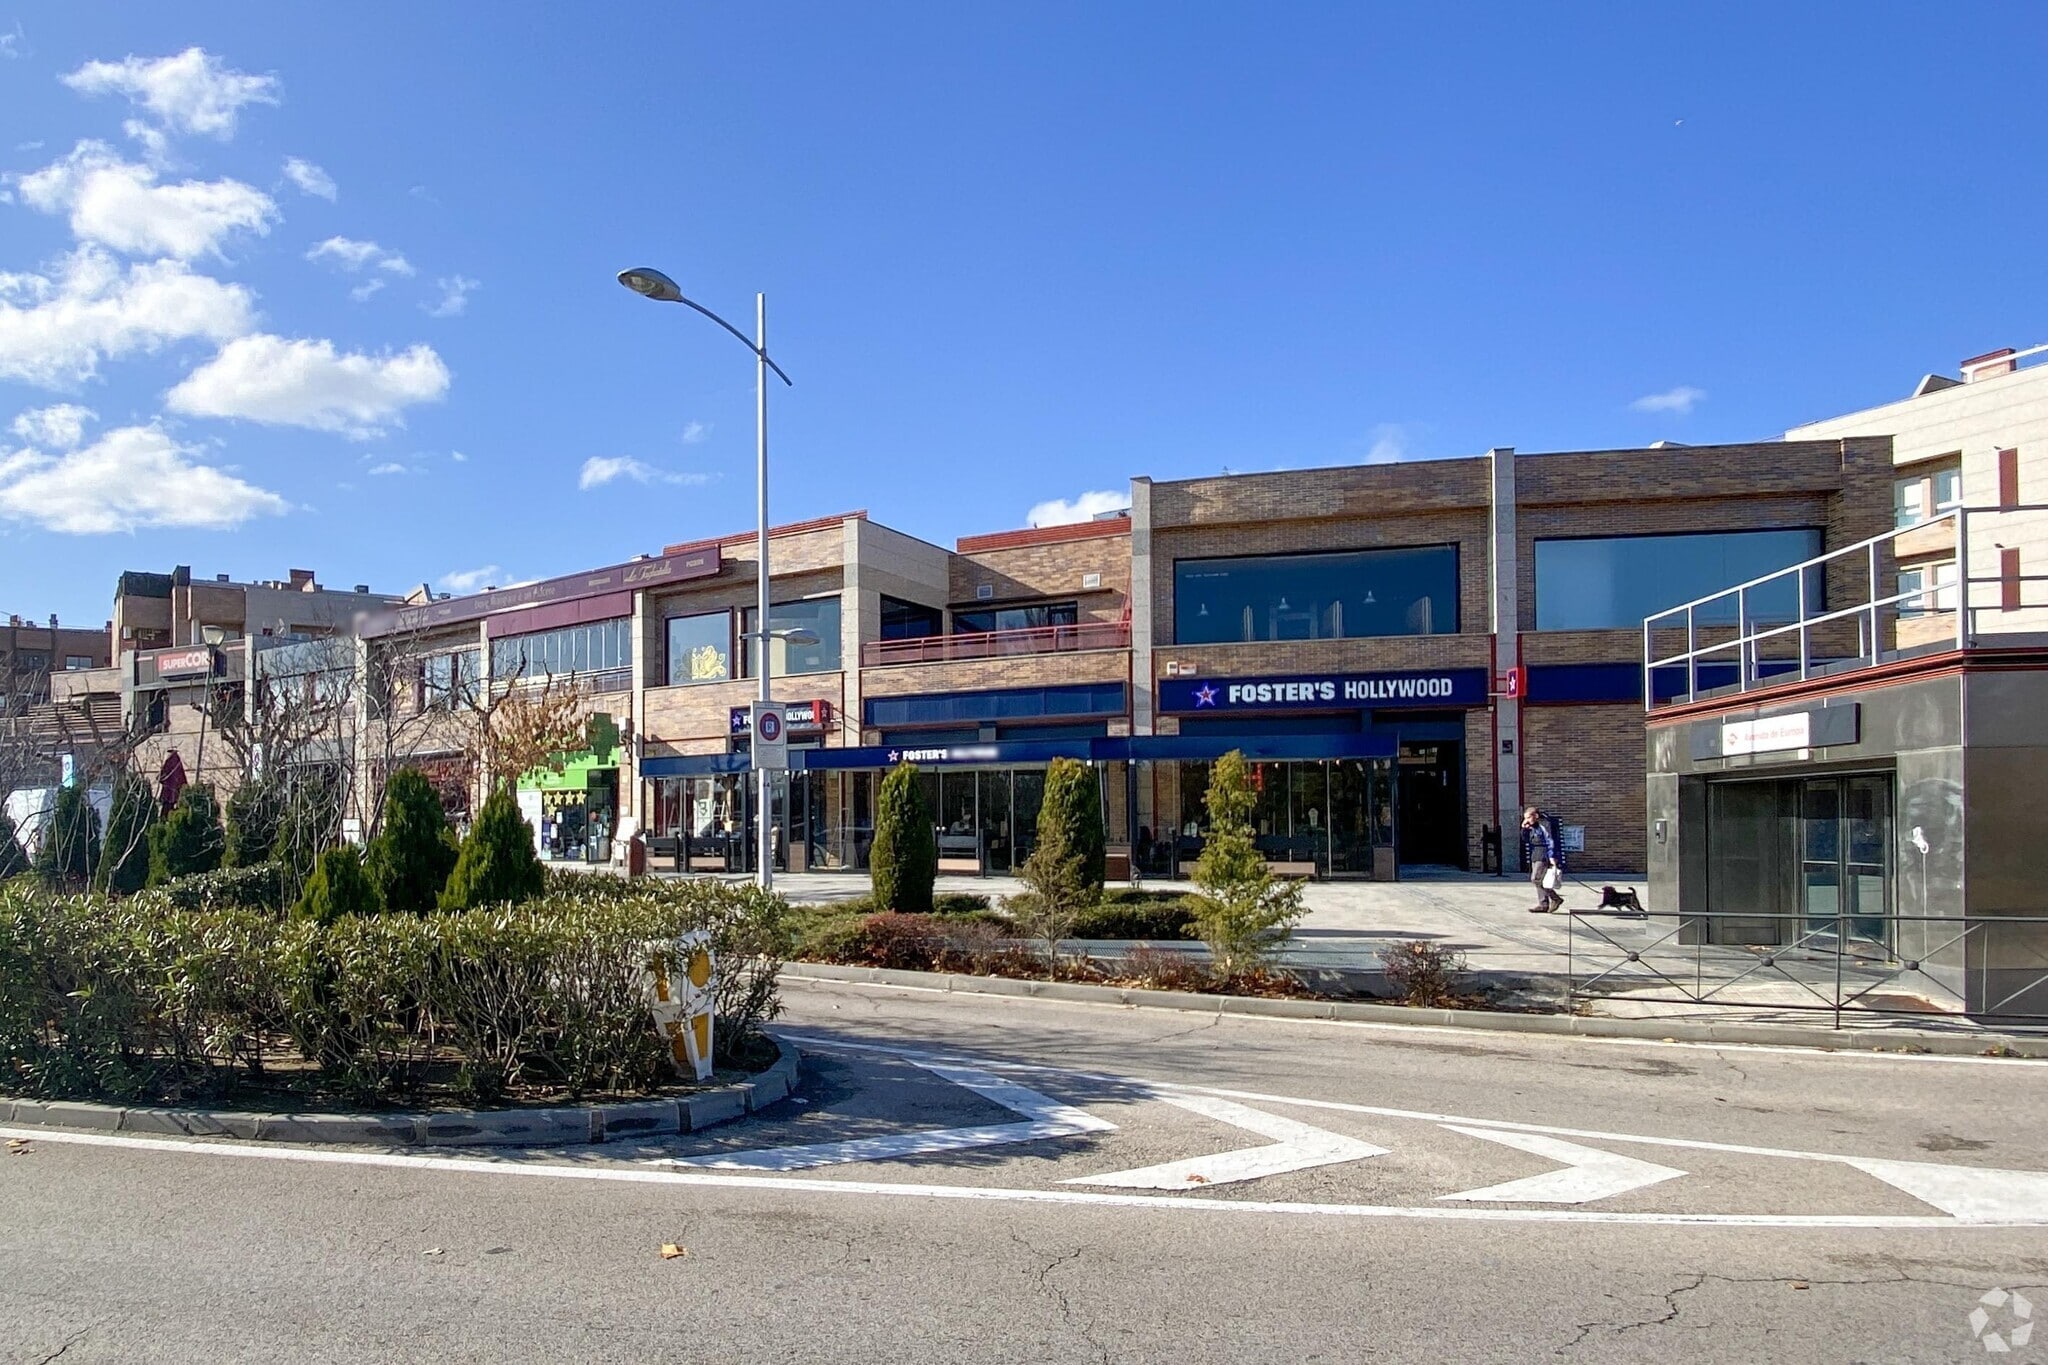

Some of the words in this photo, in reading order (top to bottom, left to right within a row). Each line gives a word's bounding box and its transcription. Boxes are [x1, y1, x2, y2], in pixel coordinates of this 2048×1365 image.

[163, 652, 210, 669] SUPERCOR
[1229, 682, 1336, 704] FOSTER'S
[1344, 678, 1453, 700] HOLLYWOOD
[786, 710, 814, 721] OLLYWO
[902, 749, 947, 760] FOSTER'S
